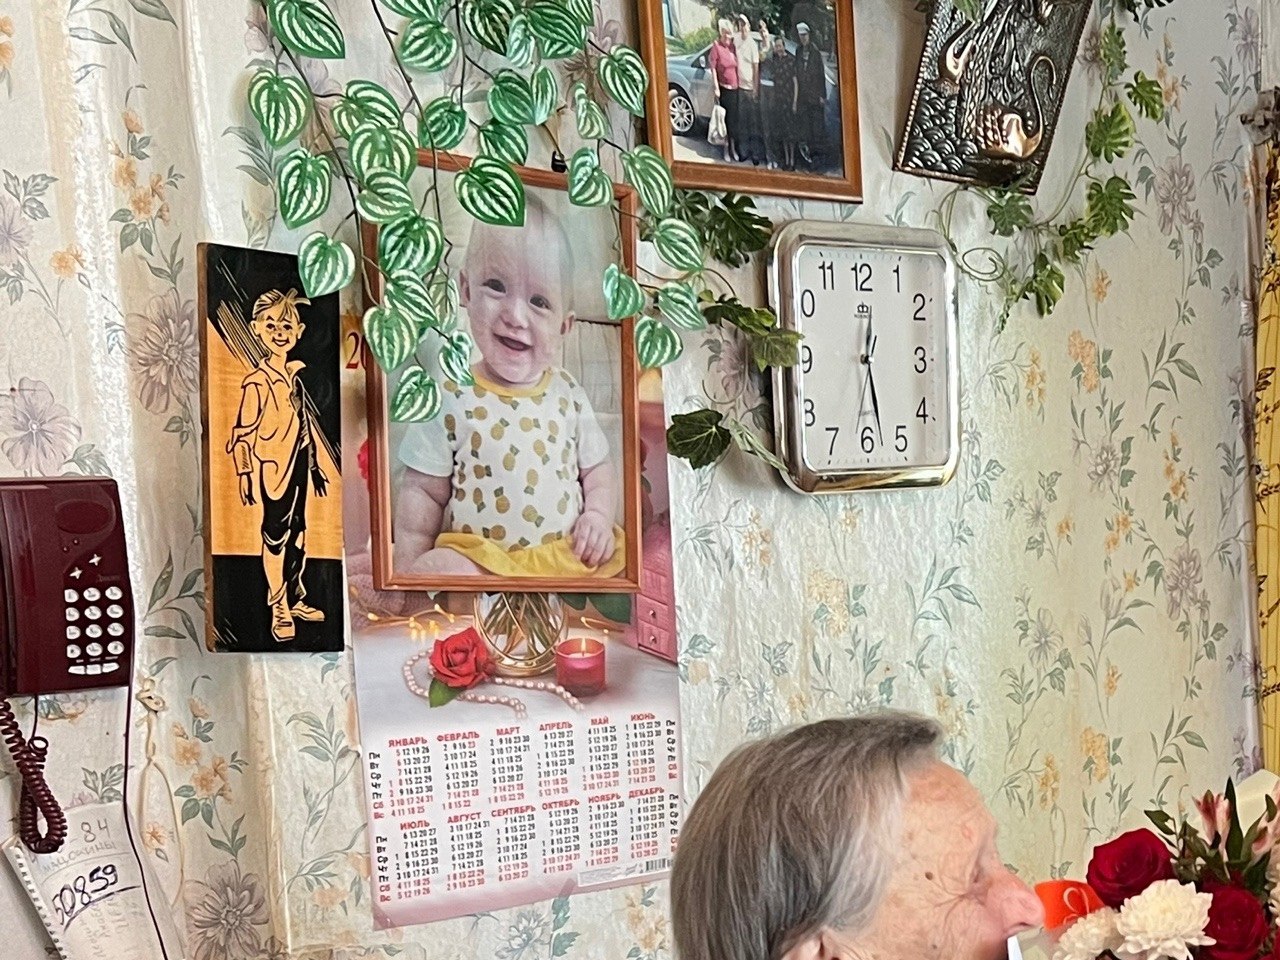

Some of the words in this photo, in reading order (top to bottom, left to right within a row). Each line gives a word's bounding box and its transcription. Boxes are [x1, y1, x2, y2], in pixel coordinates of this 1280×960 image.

[818, 260, 835, 290] 11
[851, 262, 873, 292] 12
[892, 264, 900, 293] 1
[913, 293, 926, 321] 2
[800, 345, 813, 374] 9
[914, 347, 927, 374] 3
[916, 397, 929, 424] 4
[825, 427, 840, 455] 7
[861, 427, 875, 454] 6
[895, 425, 907, 453] 5
[389, 737, 427, 747] ЯНВАРЬ
[437, 731, 479, 741] ФЕВРАЛЬ
[496, 727, 520, 736] МАРТ
[540, 721, 573, 731] АПРЕЛЬ
[591, 716, 609, 725] МАЙ
[631, 713, 655, 721] ИЮНЬ
[371, 772, 381, 780] Ср
[373, 801, 384, 809] Сб
[400, 820, 430, 830] ИЮЛЬ
[447, 812, 482, 823] АВГУСТ
[491, 805, 536, 817] СЕНТЯБРЬ
[542, 799, 579, 810] ОКТЯБРЬ
[588, 793, 621, 803] НОЯБРЬ
[629, 787, 664, 798] ДЕКАБРЬ
[377, 856, 388, 864] Ср
[52, 864, 118, 926] 50859
[380, 884, 390, 892] Сб
